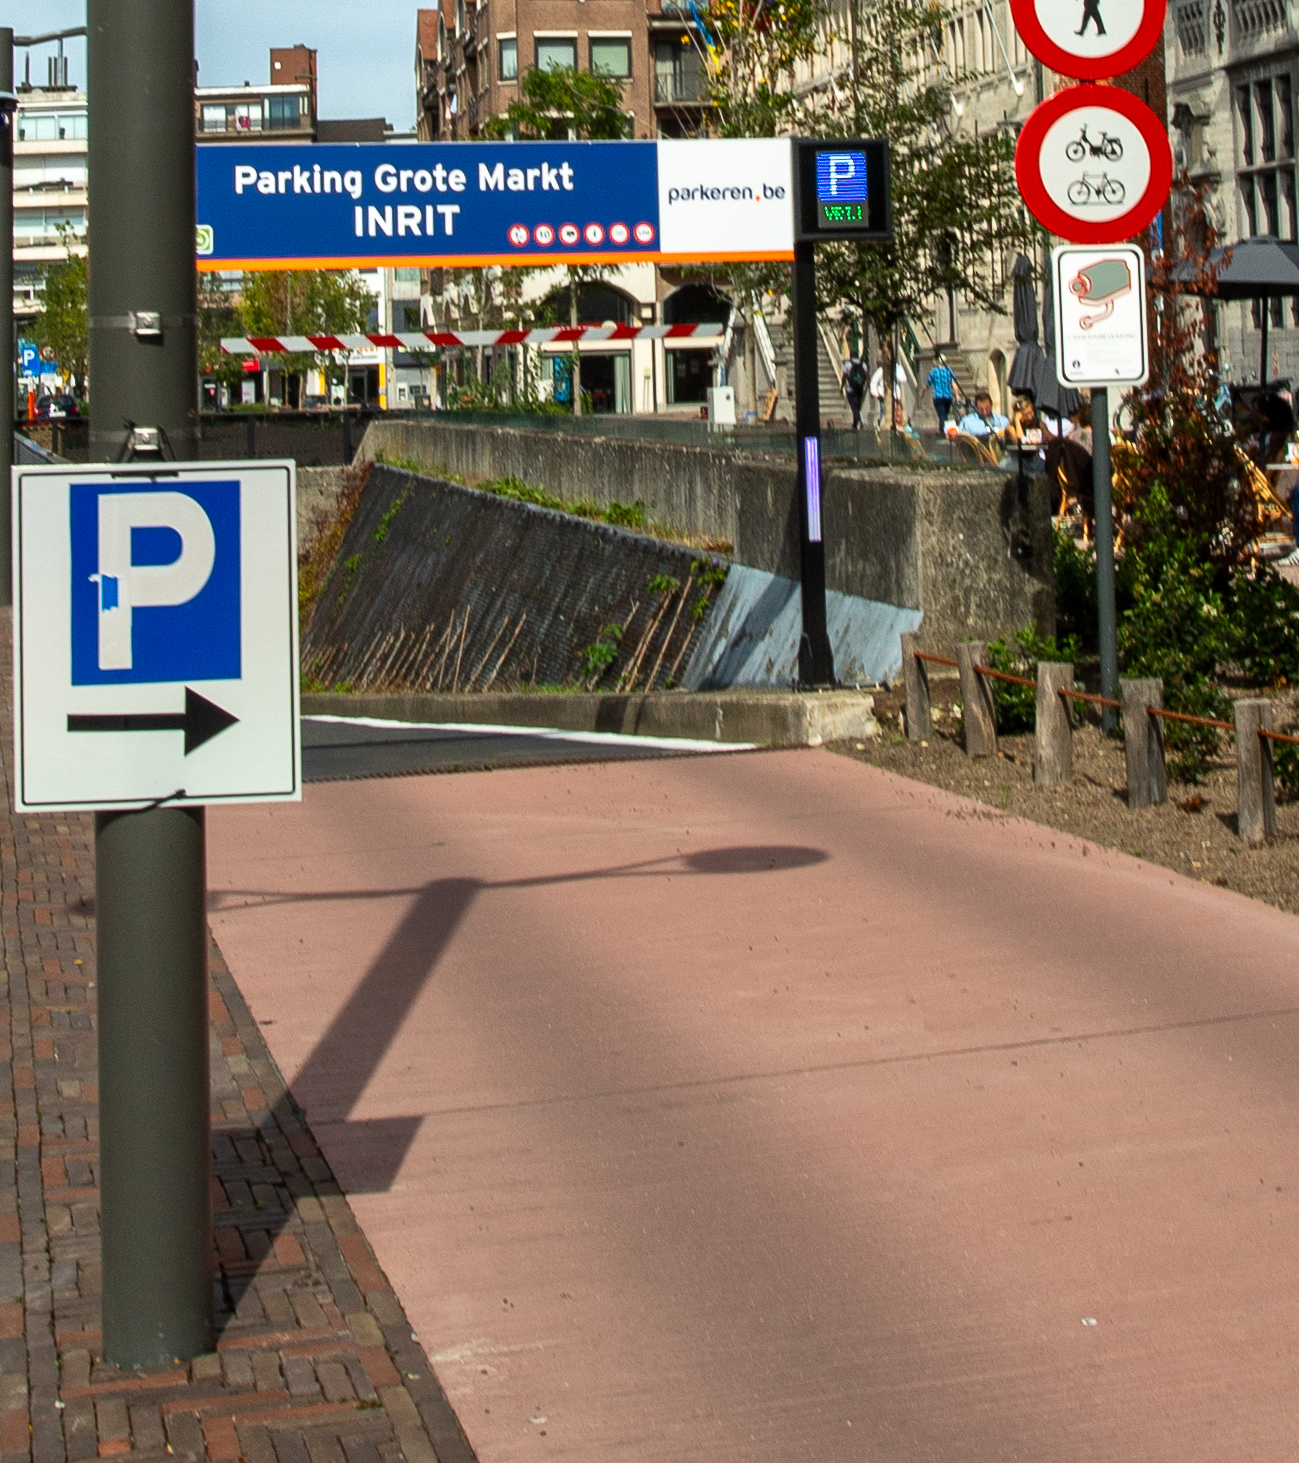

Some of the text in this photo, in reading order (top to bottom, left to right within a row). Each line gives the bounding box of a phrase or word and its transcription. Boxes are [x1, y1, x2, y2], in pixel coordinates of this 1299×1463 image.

[234, 160, 574, 199] Parking Grote Markt
[668, 182, 786, 205] parkeren.be
[829, 155, 856, 195] P
[354, 203, 461, 238] INRIT
[23, 349, 35, 367] P
[97, 491, 216, 670] P
